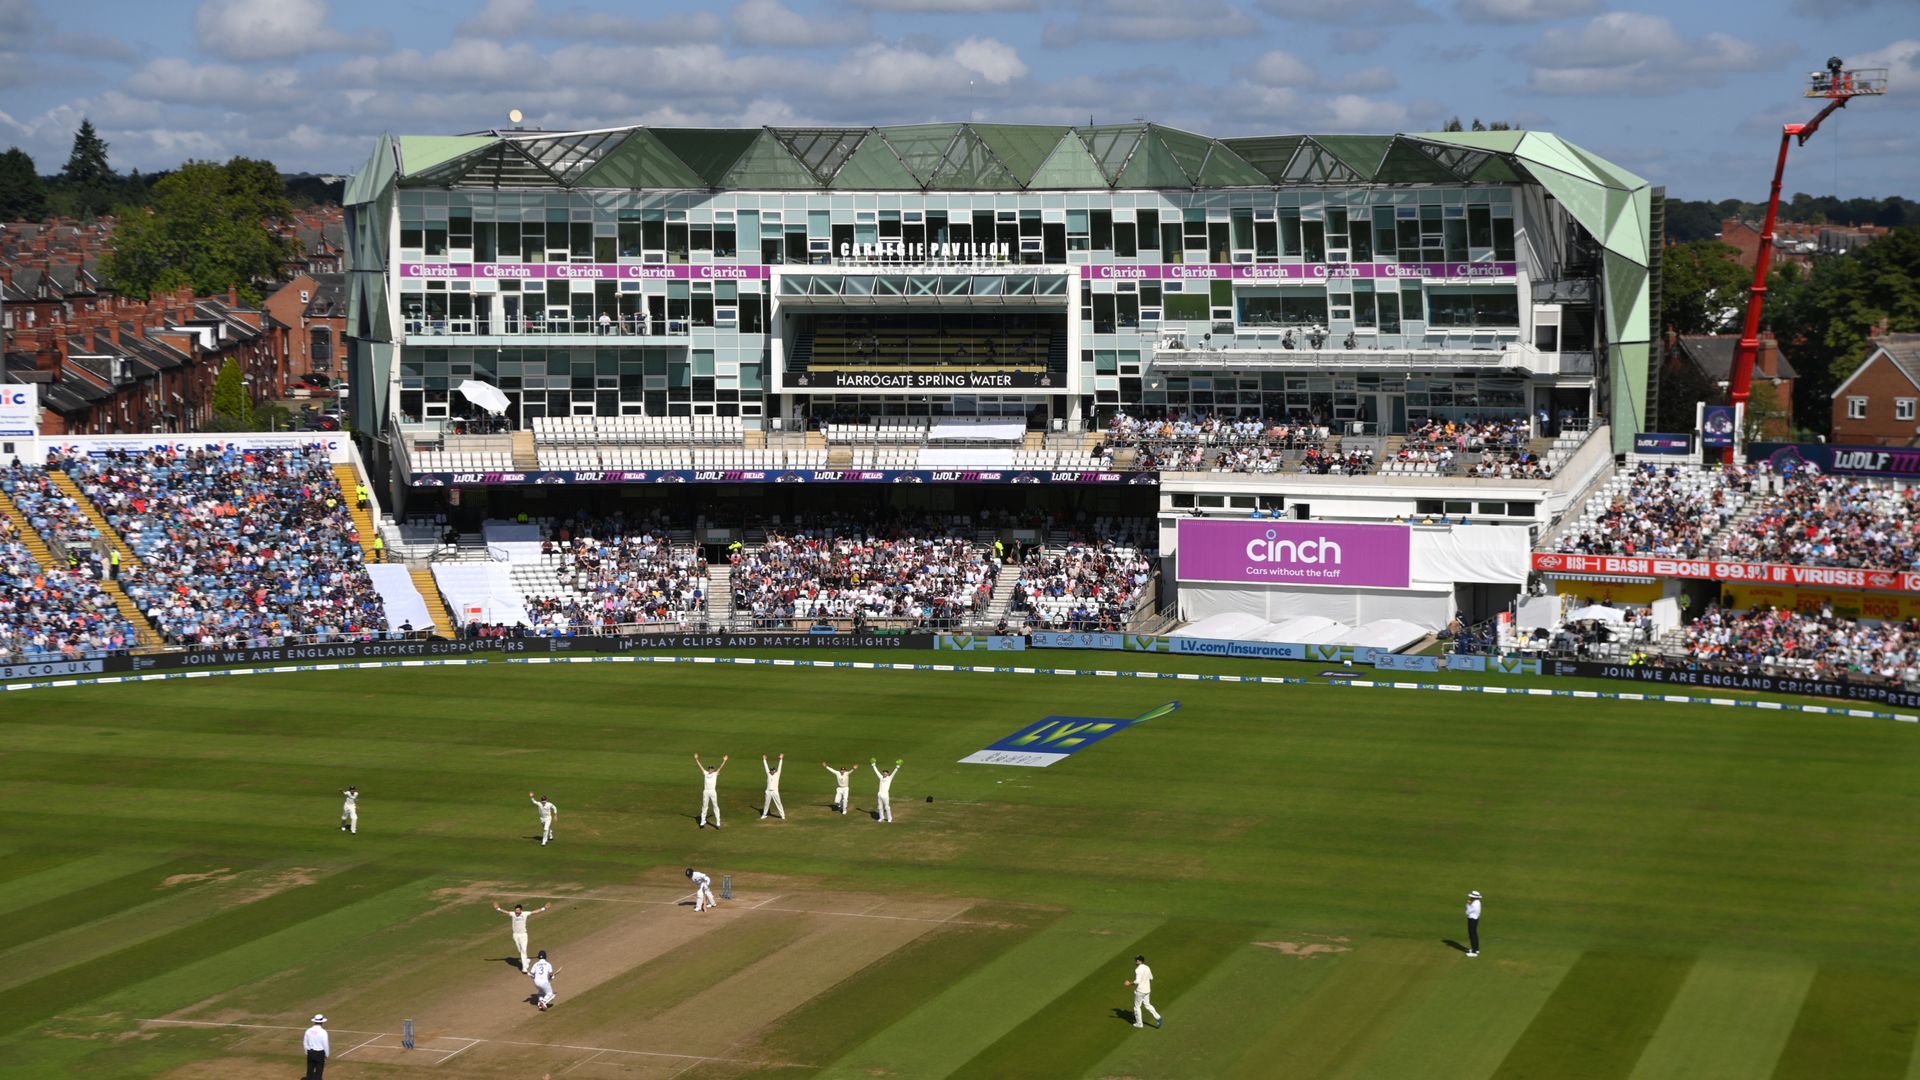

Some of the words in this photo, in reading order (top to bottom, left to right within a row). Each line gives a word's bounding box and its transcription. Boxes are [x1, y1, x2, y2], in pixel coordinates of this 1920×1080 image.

[840, 242, 924, 256] CARNEGIE
[930, 242, 1010, 256] PAVILION
[410, 265, 458, 276] Clarion
[484, 266, 531, 276] Clarion
[556, 266, 604, 277] Clarion
[629, 266, 676, 278] Clarion
[701, 266, 746, 278] Clarion
[1101, 266, 1146, 278] Clarion
[1172, 266, 1217, 277] Clarion
[1242, 266, 1288, 277] Clarion
[1314, 265, 1360, 276] Clarion
[1385, 265, 1432, 276] Clarion
[1456, 264, 1504, 276] Clarion
[836, 375, 914, 386] HARROGATE
[918, 375, 966, 386] SPRING
[970, 375, 1012, 386] WATER
[1834, 451, 1890, 470] WOLF
[1246, 530, 1342, 564] cinch
[1269, 567, 1305, 577] without
[1306, 568, 1322, 577] the
[1323, 569, 1341, 578] faff
[1606, 559, 1648, 573] BASH
[1654, 561, 1710, 576] BOSH
[1773, 567, 1788, 581] OF
[1792, 568, 1865, 586] VIRUSES
[620, 637, 676, 650] IN-PLAY
[682, 638, 722, 646] CLIPS
[728, 637, 756, 646] AND
[764, 637, 810, 646] MATCH
[817, 637, 900, 646] HIGHLIGHTS
[1180, 640, 1292, 658] LV.com/insurance
[181, 654, 216, 664] JOIN
[224, 652, 245, 663] WE
[252, 650, 280, 660] ARE
[287, 647, 356, 658] ENGLAND
[364, 644, 424, 656] CRICKET
[4, 662, 92, 677] B.CO.UK
[1601, 667, 1635, 678] JOIN
[1642, 670, 1662, 680] WE
[1669, 672, 1696, 682] ARE
[1703, 674, 1772, 690] ENGLAND
[1778, 680, 1842, 696] CRICKET
